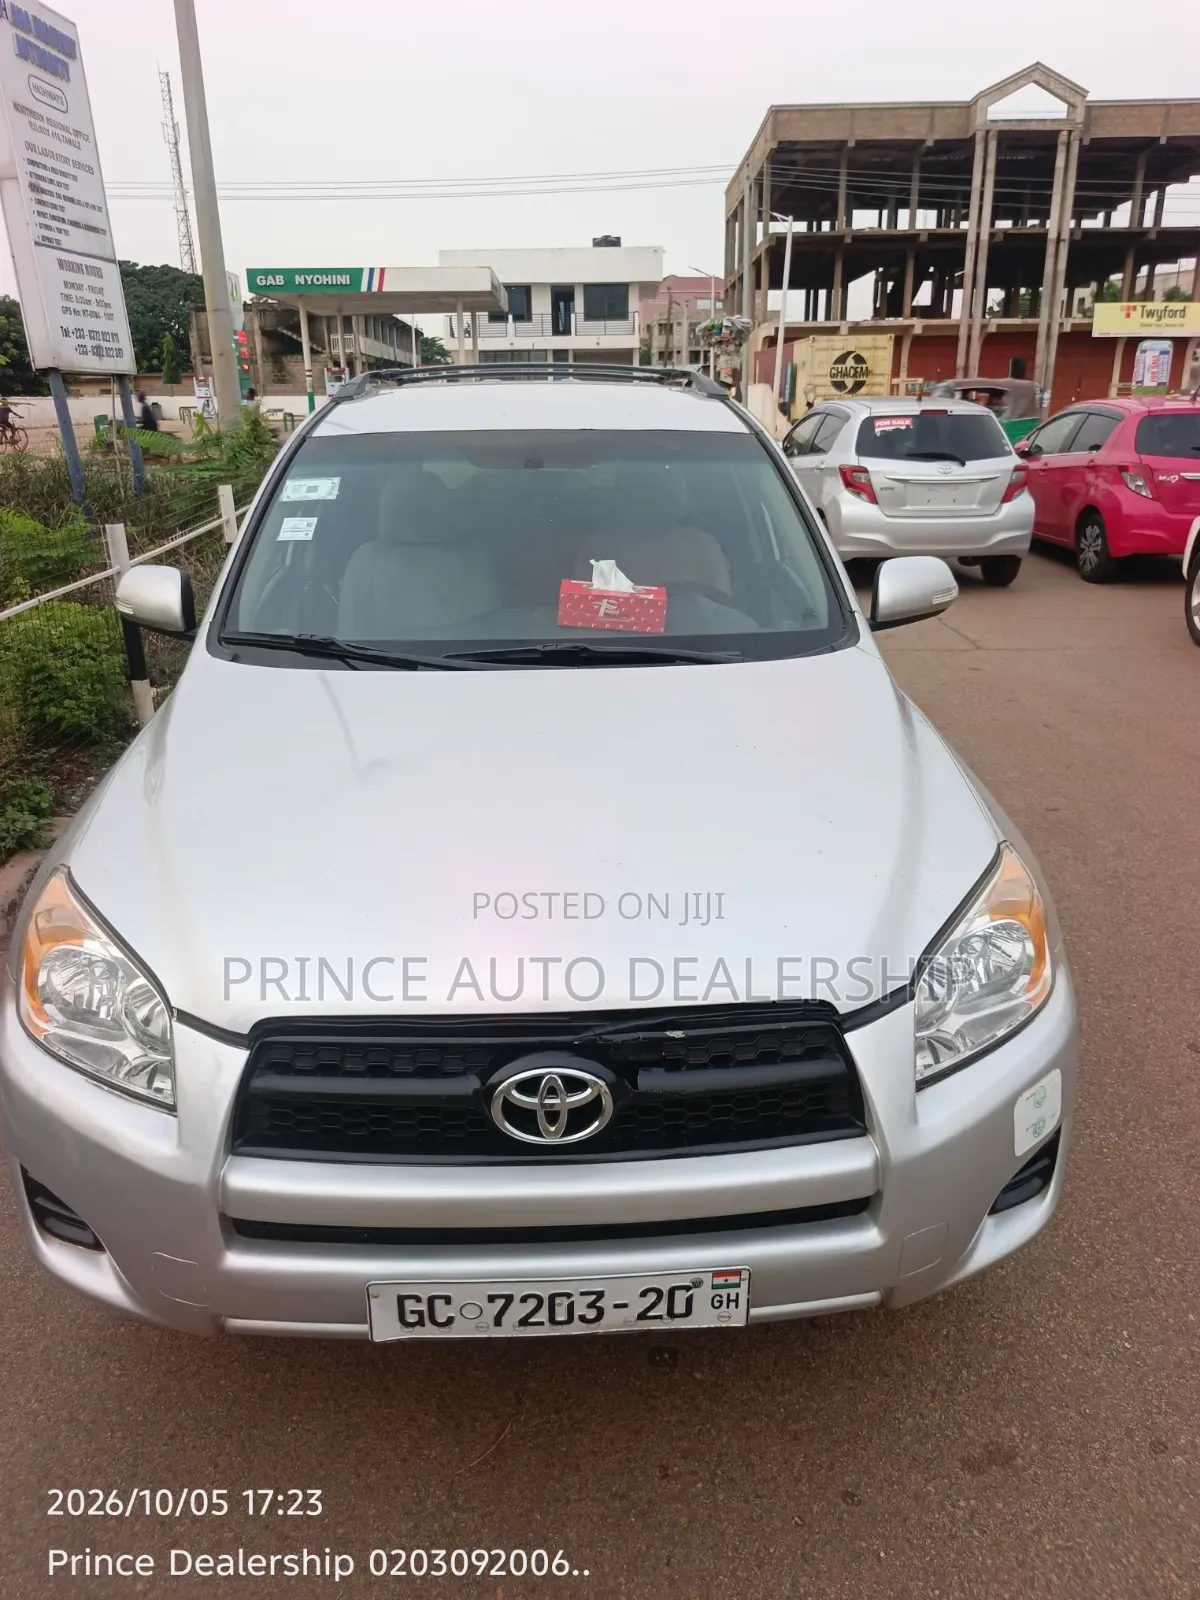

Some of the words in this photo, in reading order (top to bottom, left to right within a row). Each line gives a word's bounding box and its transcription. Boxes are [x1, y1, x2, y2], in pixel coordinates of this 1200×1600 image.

[32, 82, 65, 106] HIGHWAYS
[45, 116, 72, 136] REGIONAL
[72, 128, 91, 143] OFFICE
[71, 158, 95, 175] SERVICES
[56, 258, 85, 275] WORKING
[256, 275, 285, 286] GAB
[294, 274, 351, 286] NYOHINI
[1139, 305, 1187, 321] Twyford
[829, 365, 869, 379] GHACEM
[397, 1292, 455, 1328] GC
[710, 1292, 740, 1310] GH
